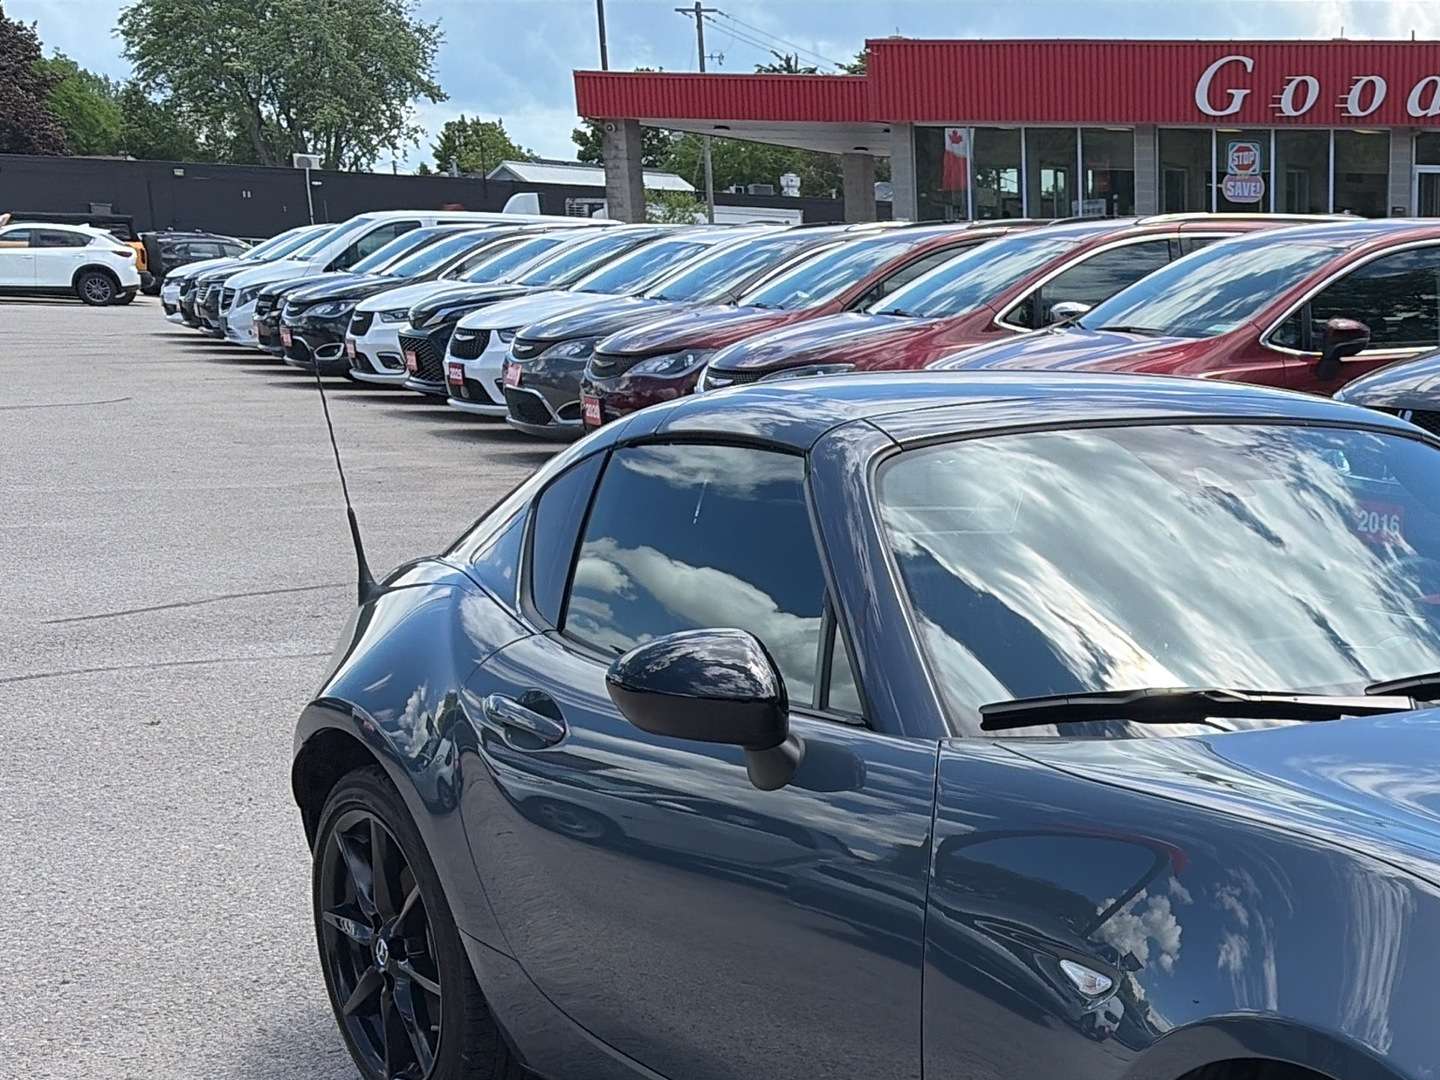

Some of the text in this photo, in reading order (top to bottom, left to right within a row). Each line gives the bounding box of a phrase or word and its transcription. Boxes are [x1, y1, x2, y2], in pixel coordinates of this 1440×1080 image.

[1231, 151, 1256, 165] STOP
[1226, 181, 1260, 197] SAVE!
[1357, 510, 1400, 534] 2016
